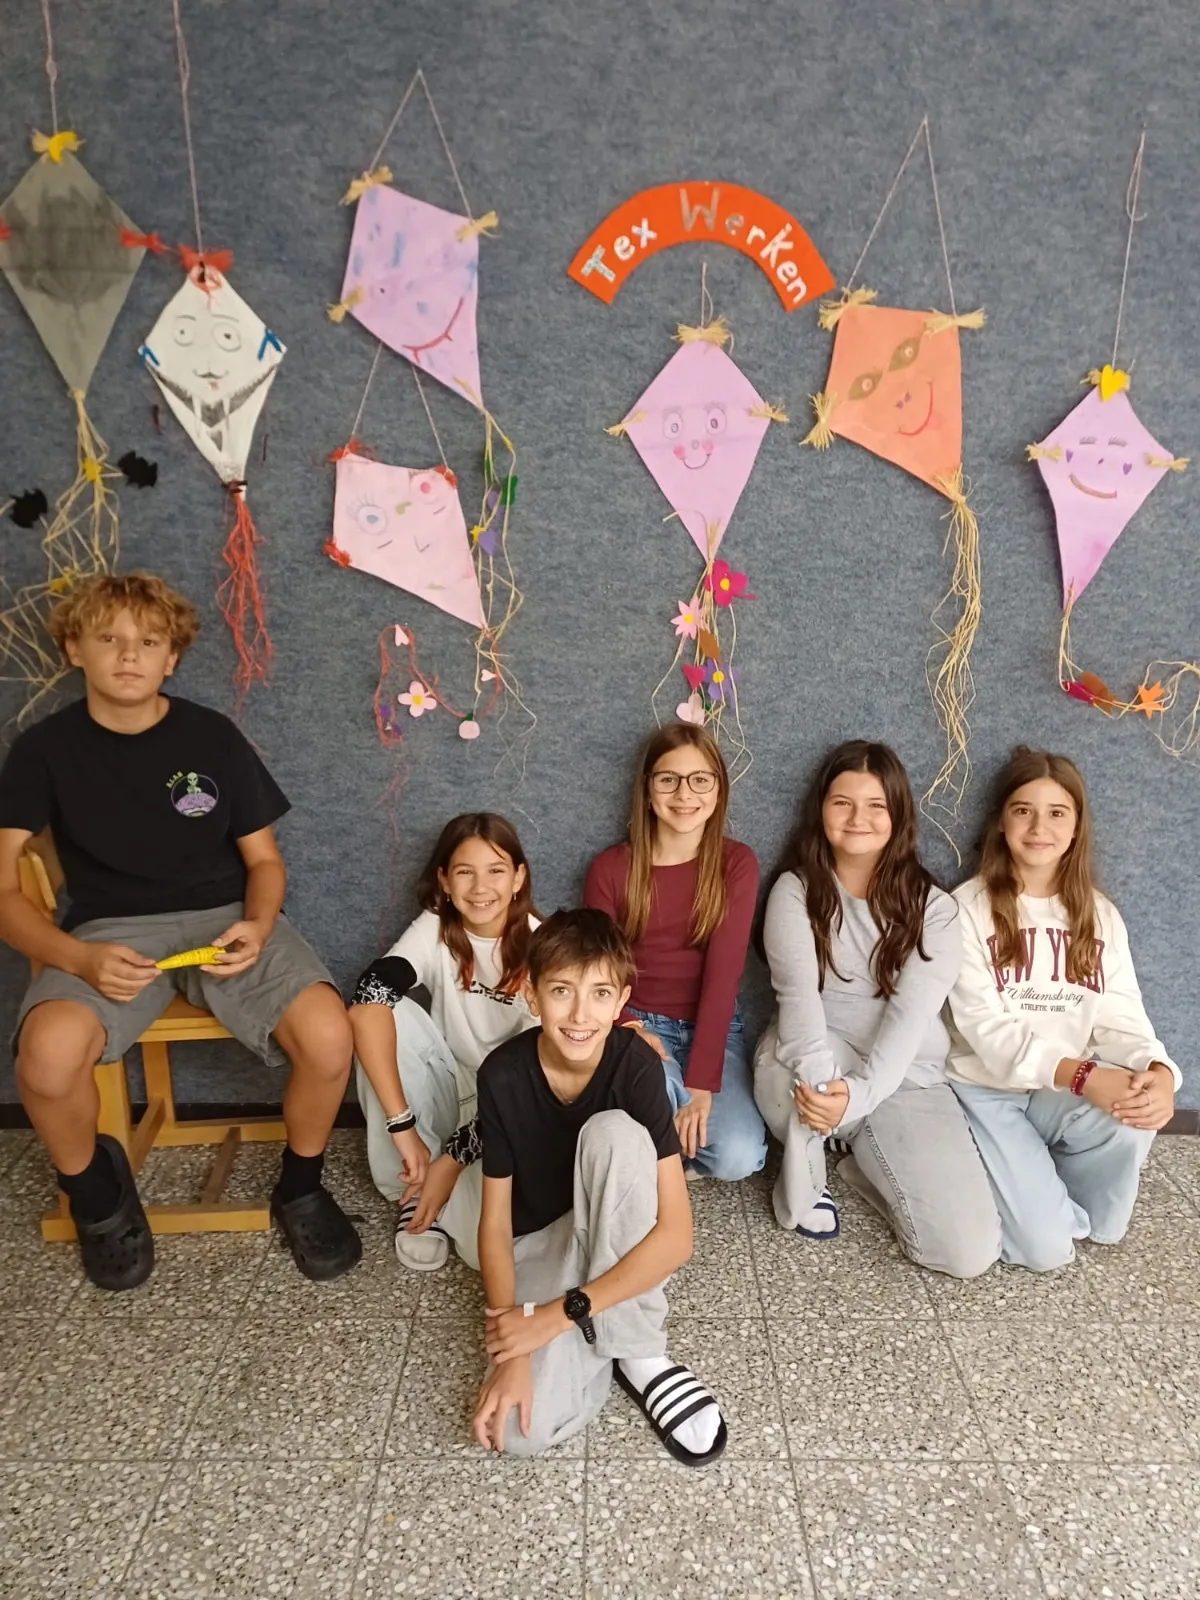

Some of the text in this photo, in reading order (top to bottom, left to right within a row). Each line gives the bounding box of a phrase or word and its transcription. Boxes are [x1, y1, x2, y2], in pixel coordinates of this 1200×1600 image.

[580, 217, 657, 283] Tex
[1005, 986, 1084, 1007] Williamsburg
[1020, 1003, 1047, 1012] ATHLETIC
